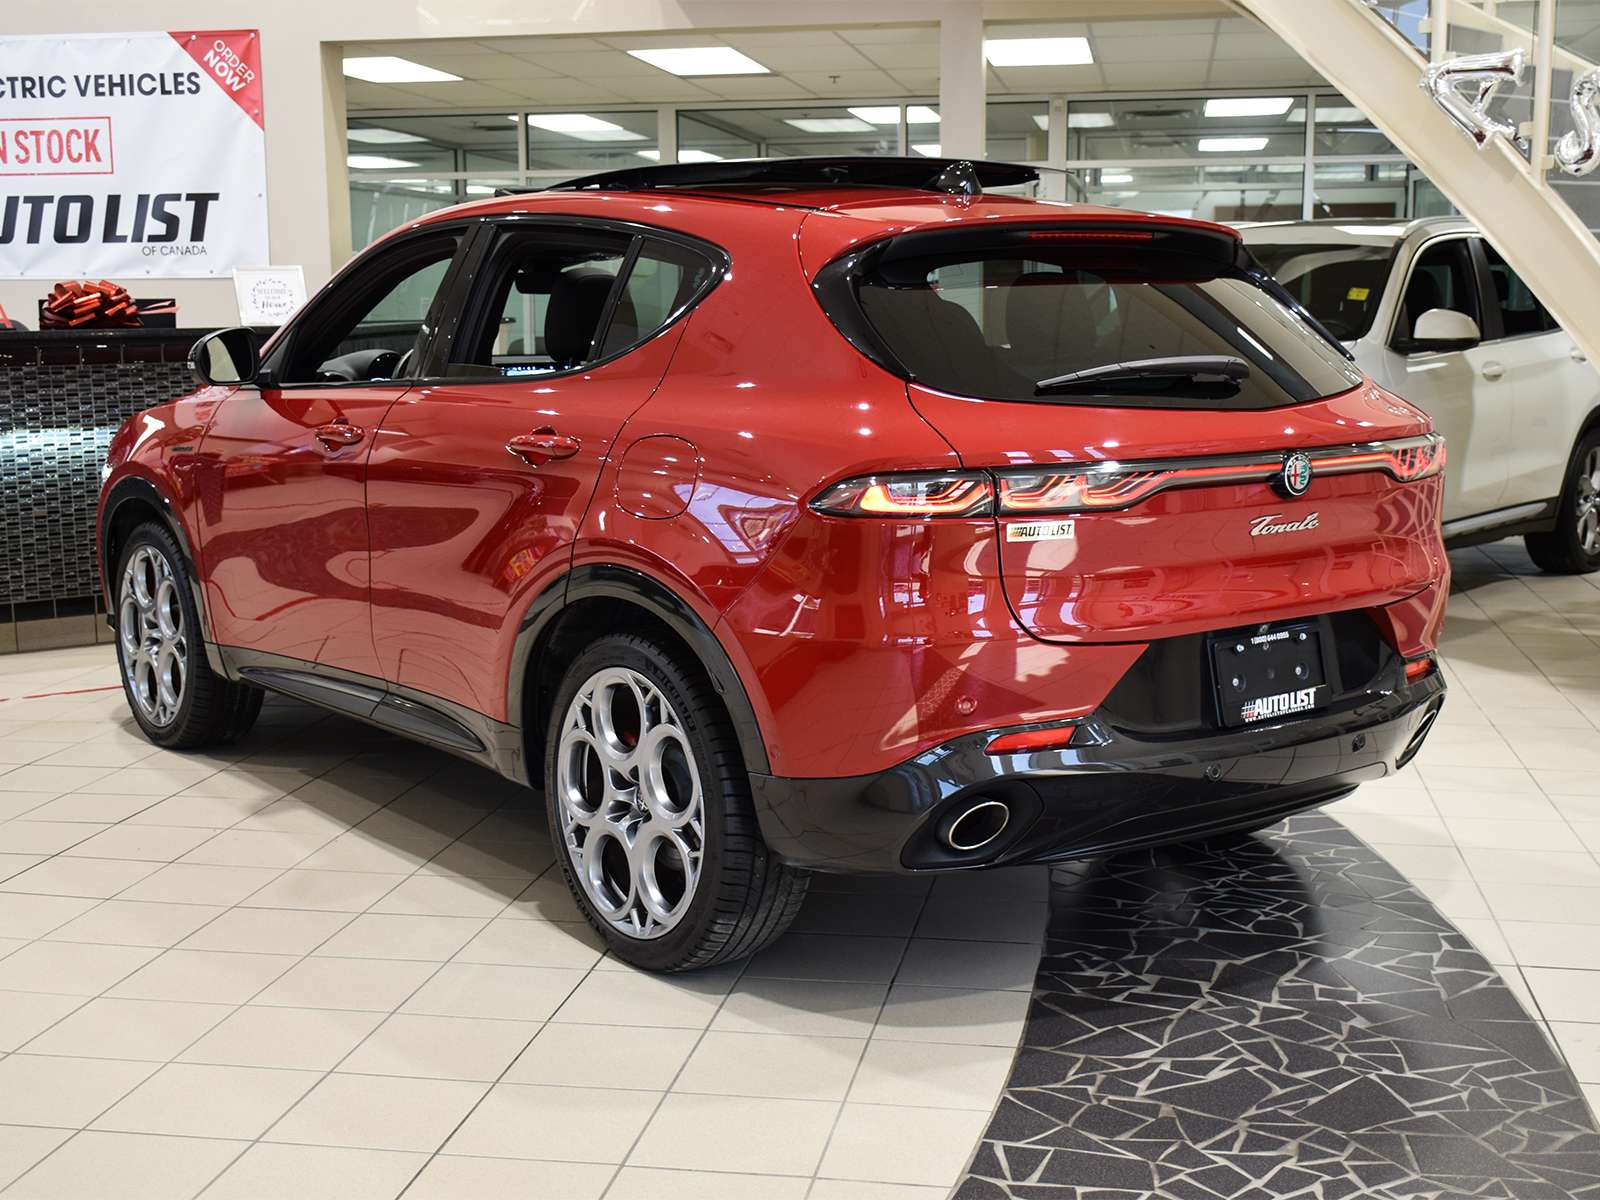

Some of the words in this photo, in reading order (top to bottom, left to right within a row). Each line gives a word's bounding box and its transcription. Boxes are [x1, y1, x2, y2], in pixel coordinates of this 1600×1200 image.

[203, 49, 247, 92] NOW
[213, 39, 255, 84] ORDER
[0, 75, 67, 98] TRIC
[73, 71, 201, 97] VEHICLES
[14, 128, 102, 164] STOCK
[102, 192, 220, 243] LIST
[141, 245, 157, 256] OF
[160, 245, 207, 256] CANADA
[1249, 512, 1319, 536] Tonale
